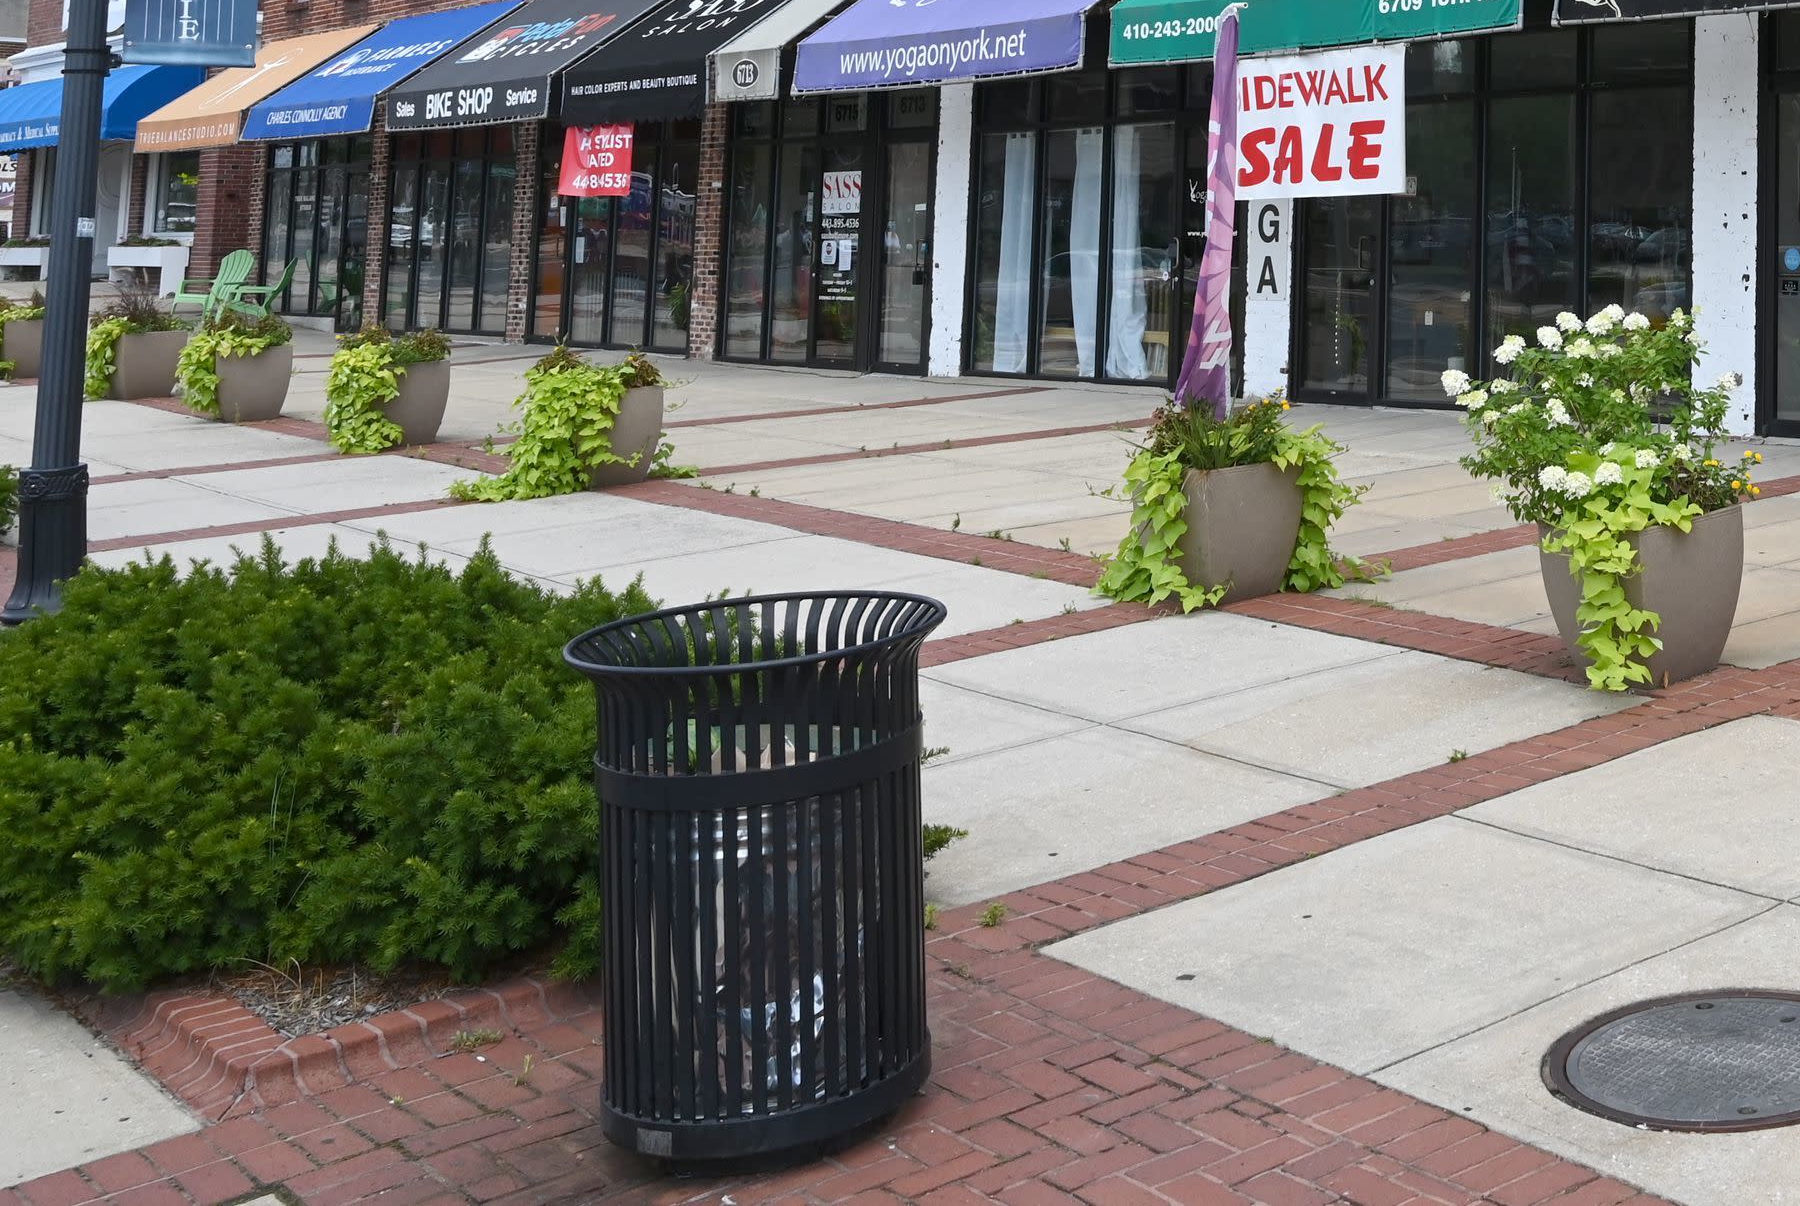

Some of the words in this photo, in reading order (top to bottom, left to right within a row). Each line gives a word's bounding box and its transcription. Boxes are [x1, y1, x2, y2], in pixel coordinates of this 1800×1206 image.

[642, 16, 740, 38] SALON
[361, 39, 453, 63] FARMERS
[484, 35, 586, 61] CYCLES
[840, 28, 1026, 79] www.yogaonyork.net
[571, 85, 583, 96] HAIR
[584, 83, 603, 95] COLOR
[603, 81, 628, 93] EXPERTS
[629, 79, 641, 91] AND
[642, 77, 665, 90] BEAUTY
[666, 74, 697, 88] BOUTIQUE
[1238, 63, 1389, 112] IDEWALK
[266, 110, 290, 126] CHARLES
[291, 107, 323, 124] CONNOLLY
[322, 105, 349, 120] AGENCY
[396, 101, 415, 118] Sales
[426, 91, 452, 120] BIKE
[457, 87, 493, 115] SHOP
[505, 87, 537, 107] Service
[139, 123, 235, 144] TRUEBALANCESTUDIO.COM
[1238, 119, 1386, 187] SALE
[823, 174, 862, 199] SASS
[823, 202, 860, 211] SALON
